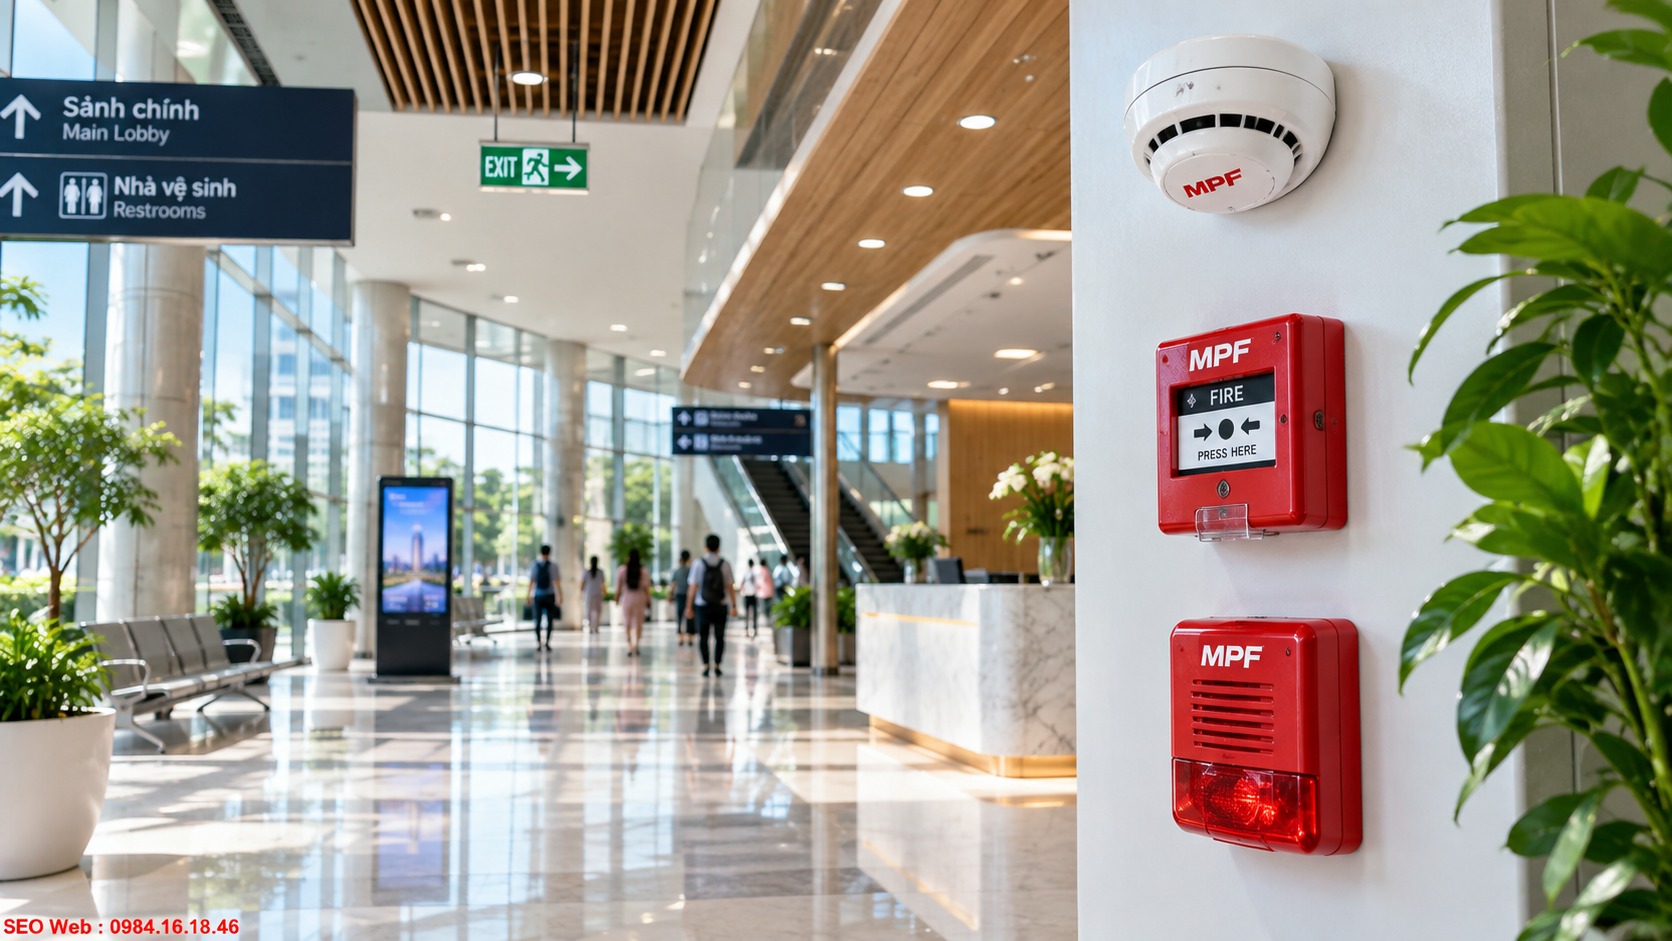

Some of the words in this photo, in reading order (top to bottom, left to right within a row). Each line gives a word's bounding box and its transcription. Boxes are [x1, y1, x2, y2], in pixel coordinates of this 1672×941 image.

[63, 96, 125, 119] Sảnh
[132, 98, 200, 121] chính
[63, 123, 108, 141] Main
[114, 124, 170, 147] Lobby
[485, 155, 518, 178] EXIT
[162, 176, 187, 202] vệ
[192, 177, 237, 198] sinh
[1183, 168, 1242, 198] MPF
[114, 201, 207, 220] Restrooms
[1189, 338, 1251, 372] MPF
[1210, 385, 1244, 406] FIRE
[1197, 447, 1228, 461] PRESS
[1231, 444, 1257, 457] HERE
[1200, 645, 1263, 669] MPF
